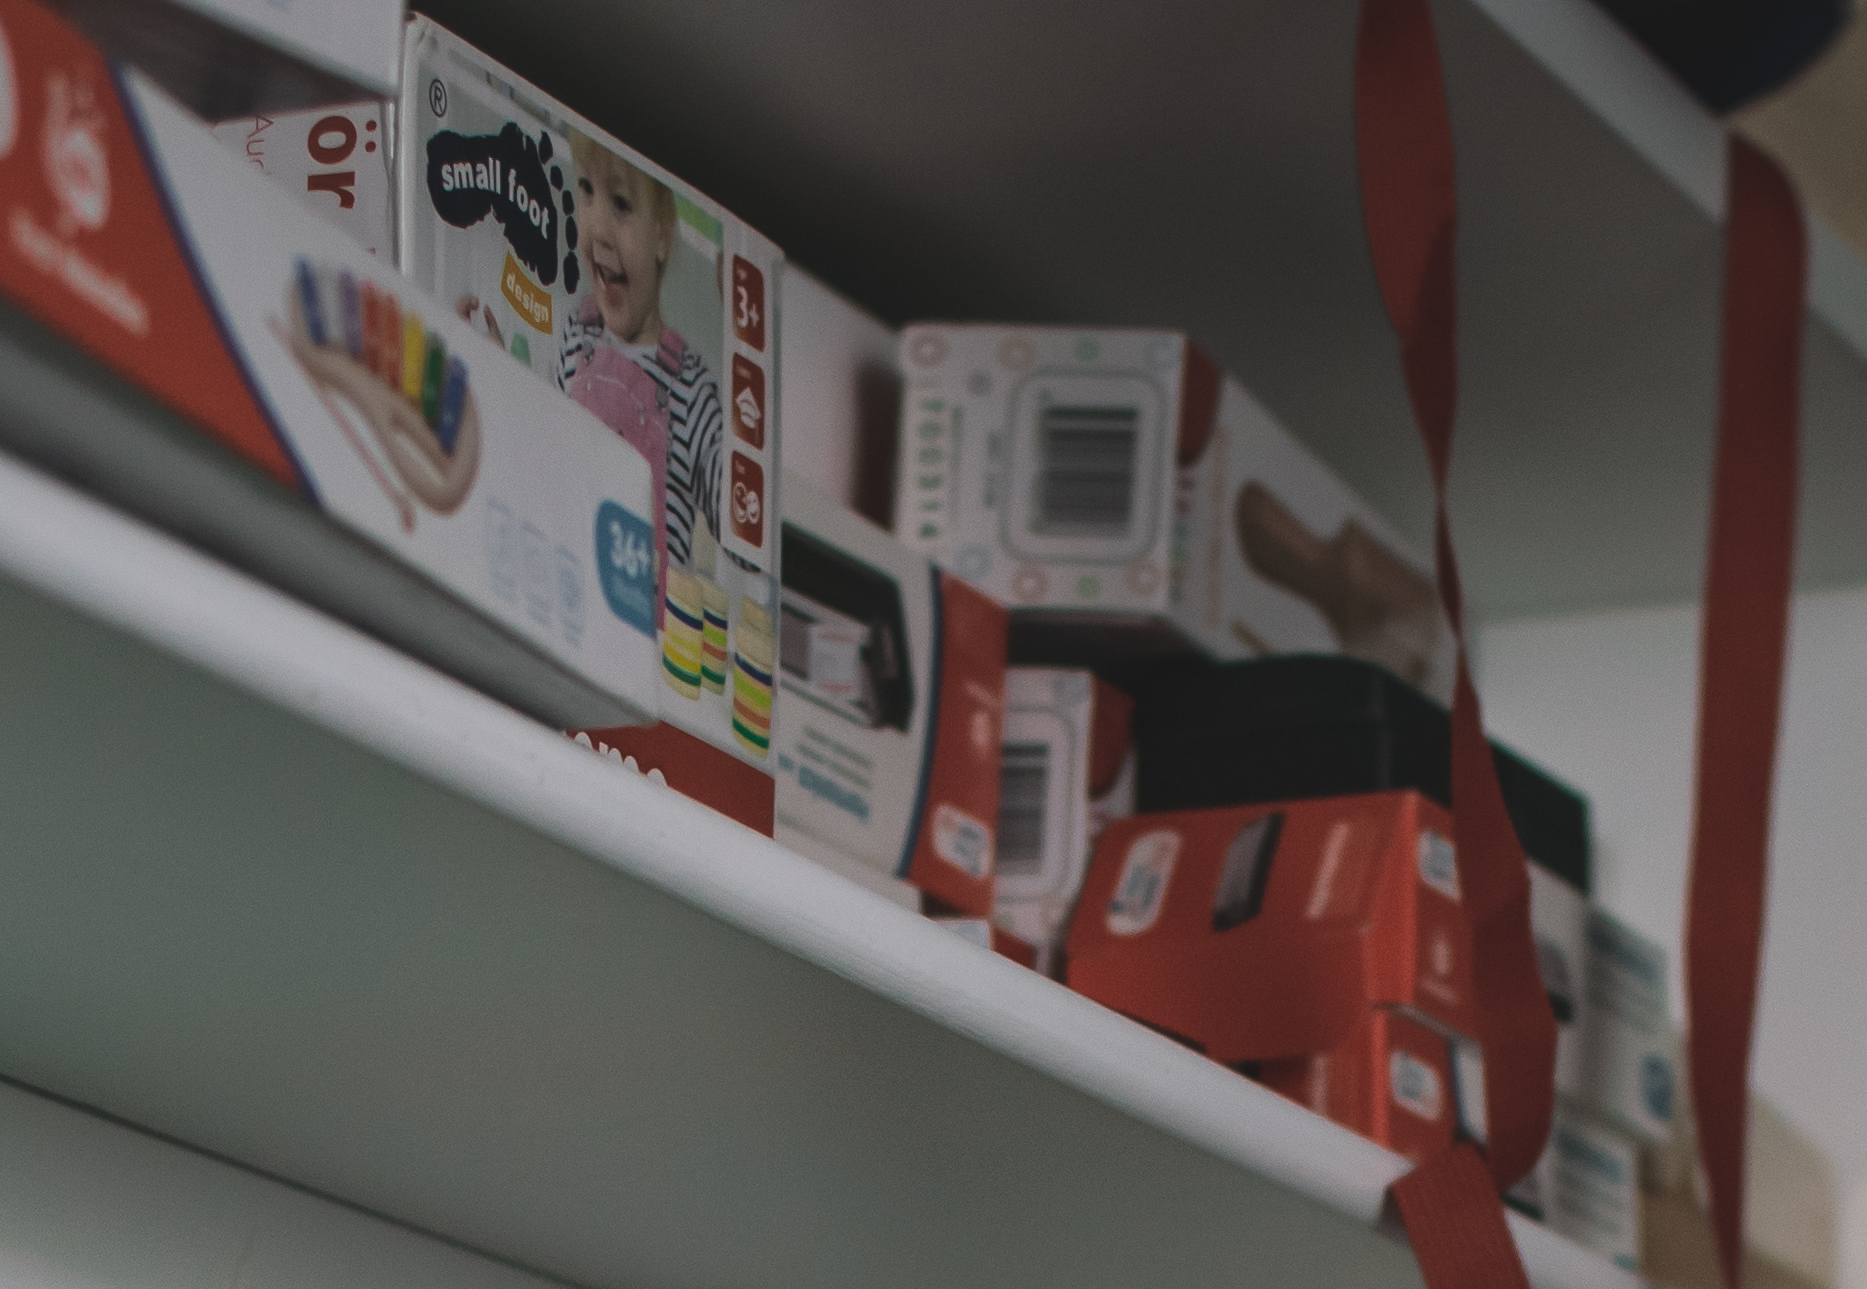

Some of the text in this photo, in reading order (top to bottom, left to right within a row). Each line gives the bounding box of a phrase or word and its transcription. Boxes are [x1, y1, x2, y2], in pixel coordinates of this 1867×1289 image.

[441, 156, 552, 240] small foot
[505, 273, 551, 323] design
[735, 286, 761, 332] 3+
[609, 519, 651, 578] 36+
